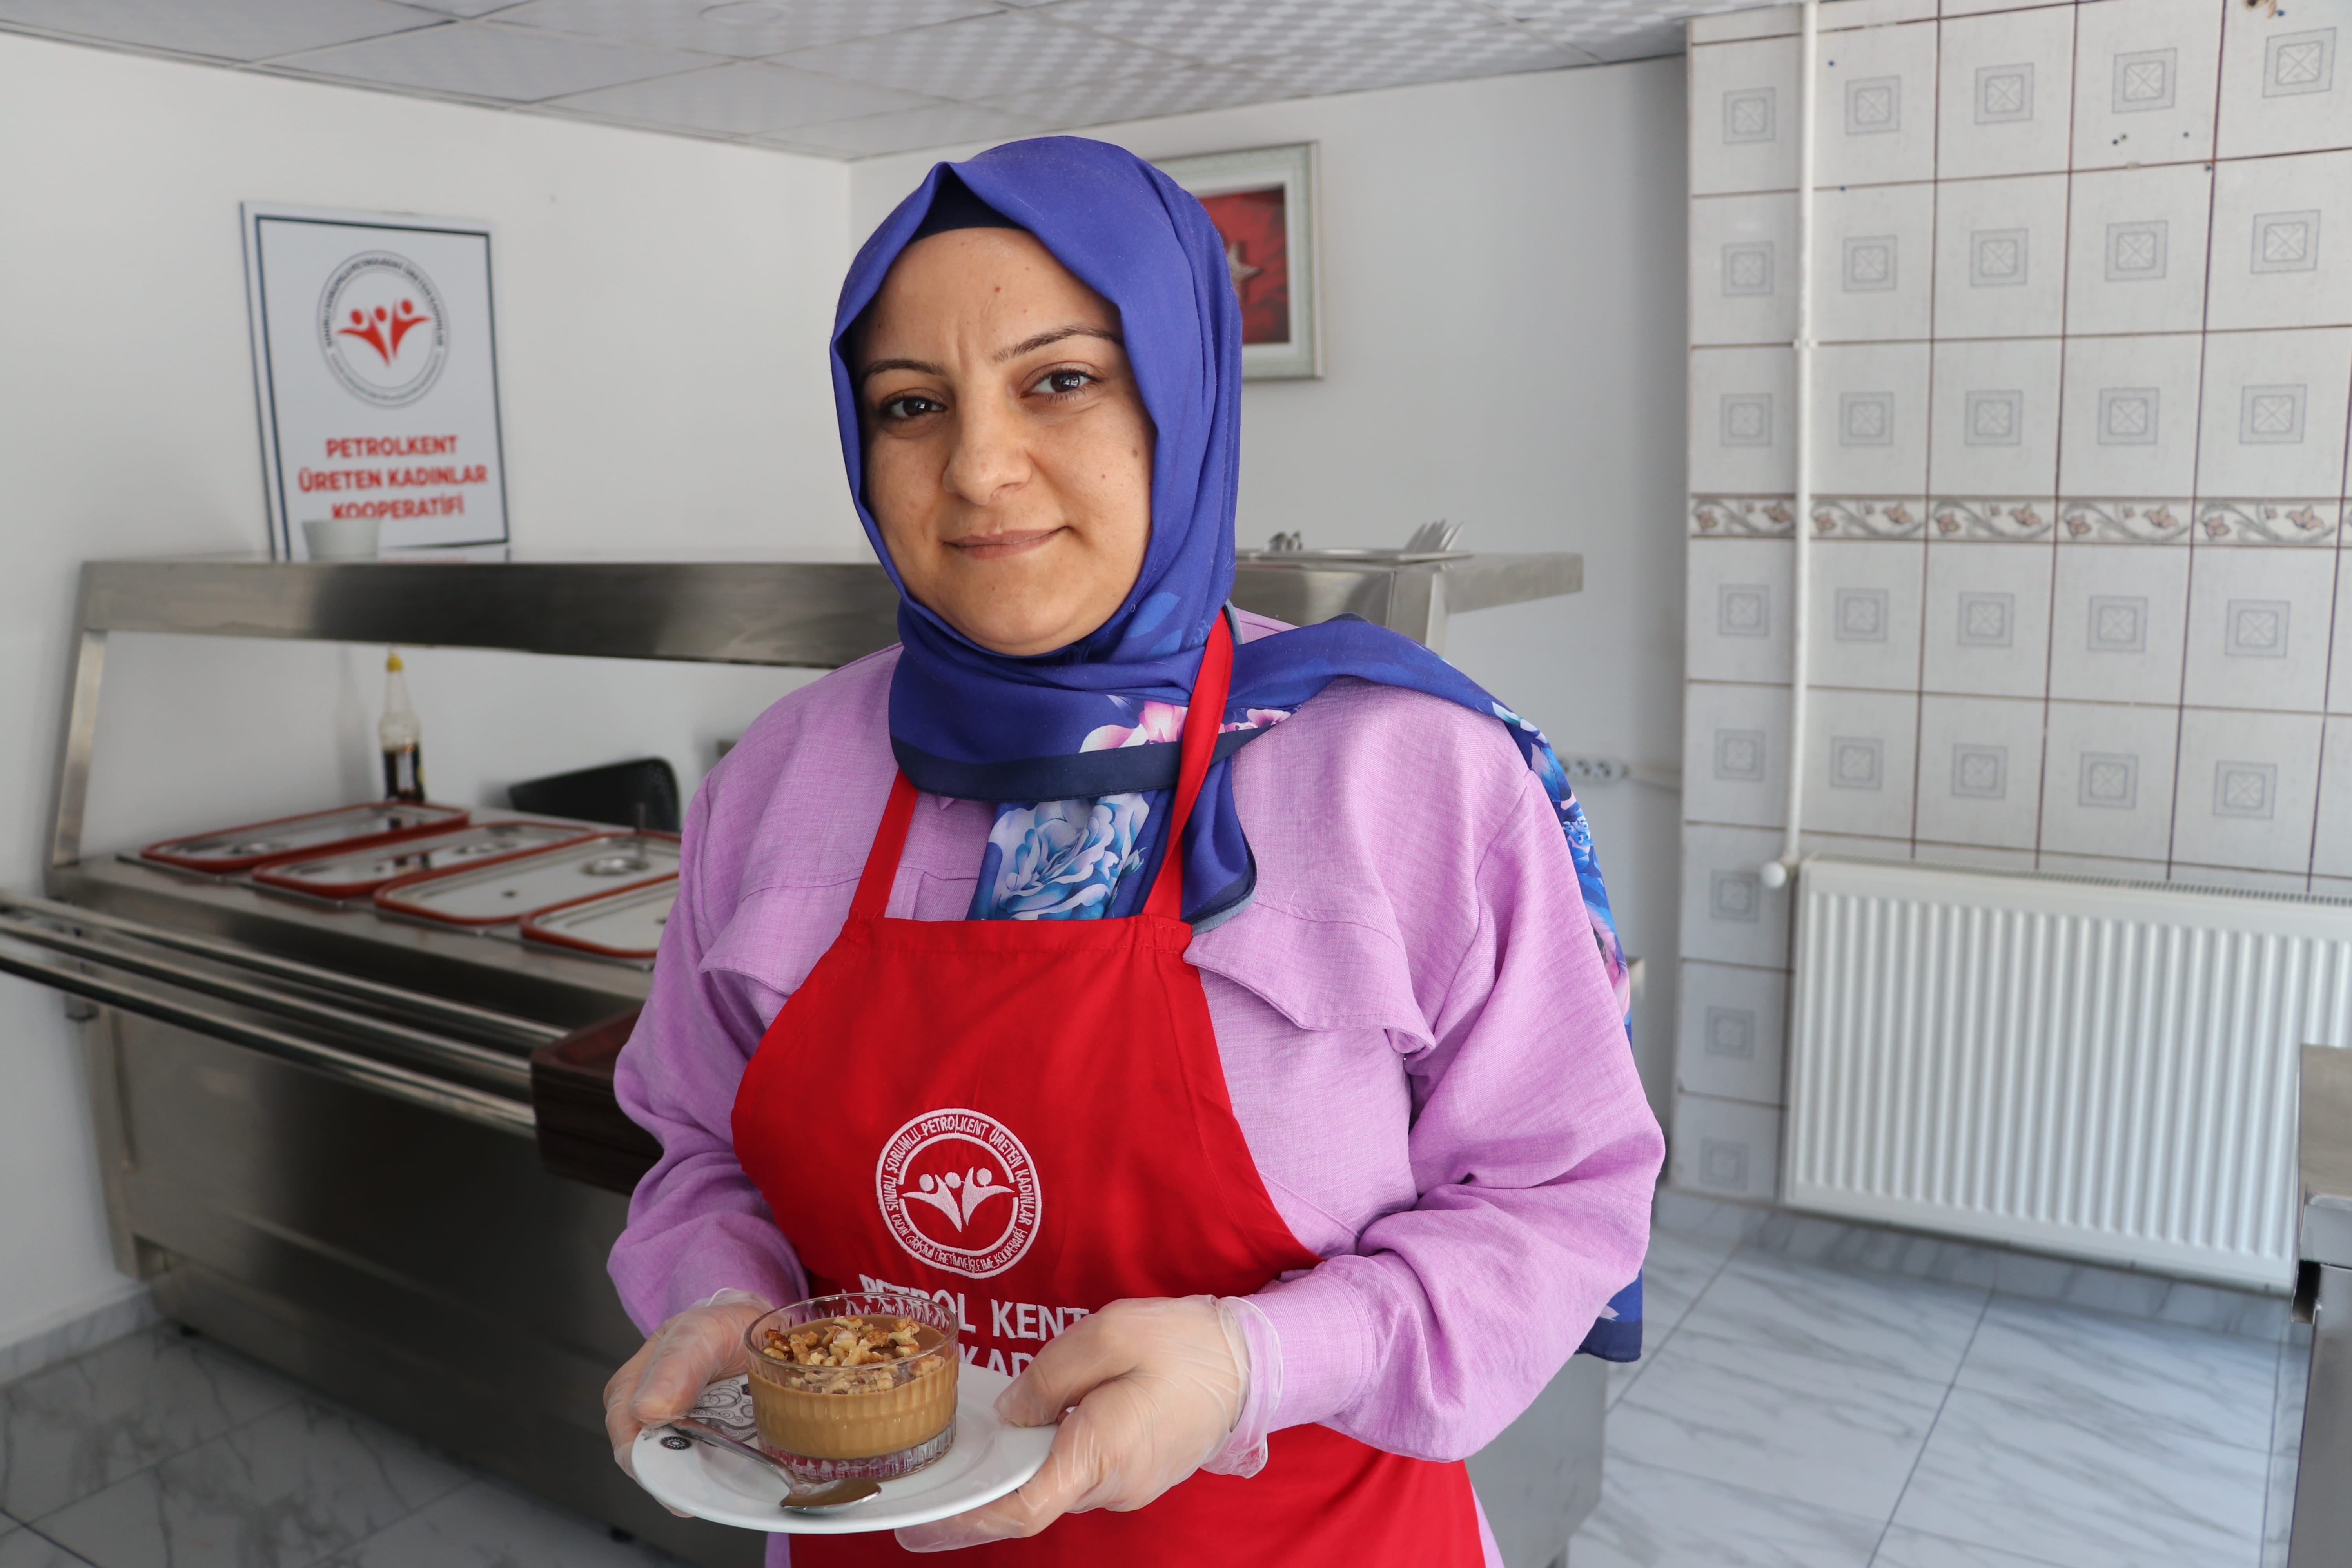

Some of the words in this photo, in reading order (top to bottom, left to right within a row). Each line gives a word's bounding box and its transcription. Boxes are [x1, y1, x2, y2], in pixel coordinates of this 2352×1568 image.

[326, 435, 457, 458] PETROLKENT
[298, 467, 382, 491] ÜRETEN
[388, 465, 488, 487] KADINLAR
[332, 492, 465, 519] KOOPERATİFİ
[920, 1114, 989, 1137] PETROLKENT
[885, 1127, 921, 1174] SORUMLU
[989, 1127, 1025, 1169] ÜRETEN
[883, 1174, 899, 1211] SINIRLI
[1015, 1169, 1035, 1226] KADINLAR
[991, 1299, 1089, 1341] KENT
